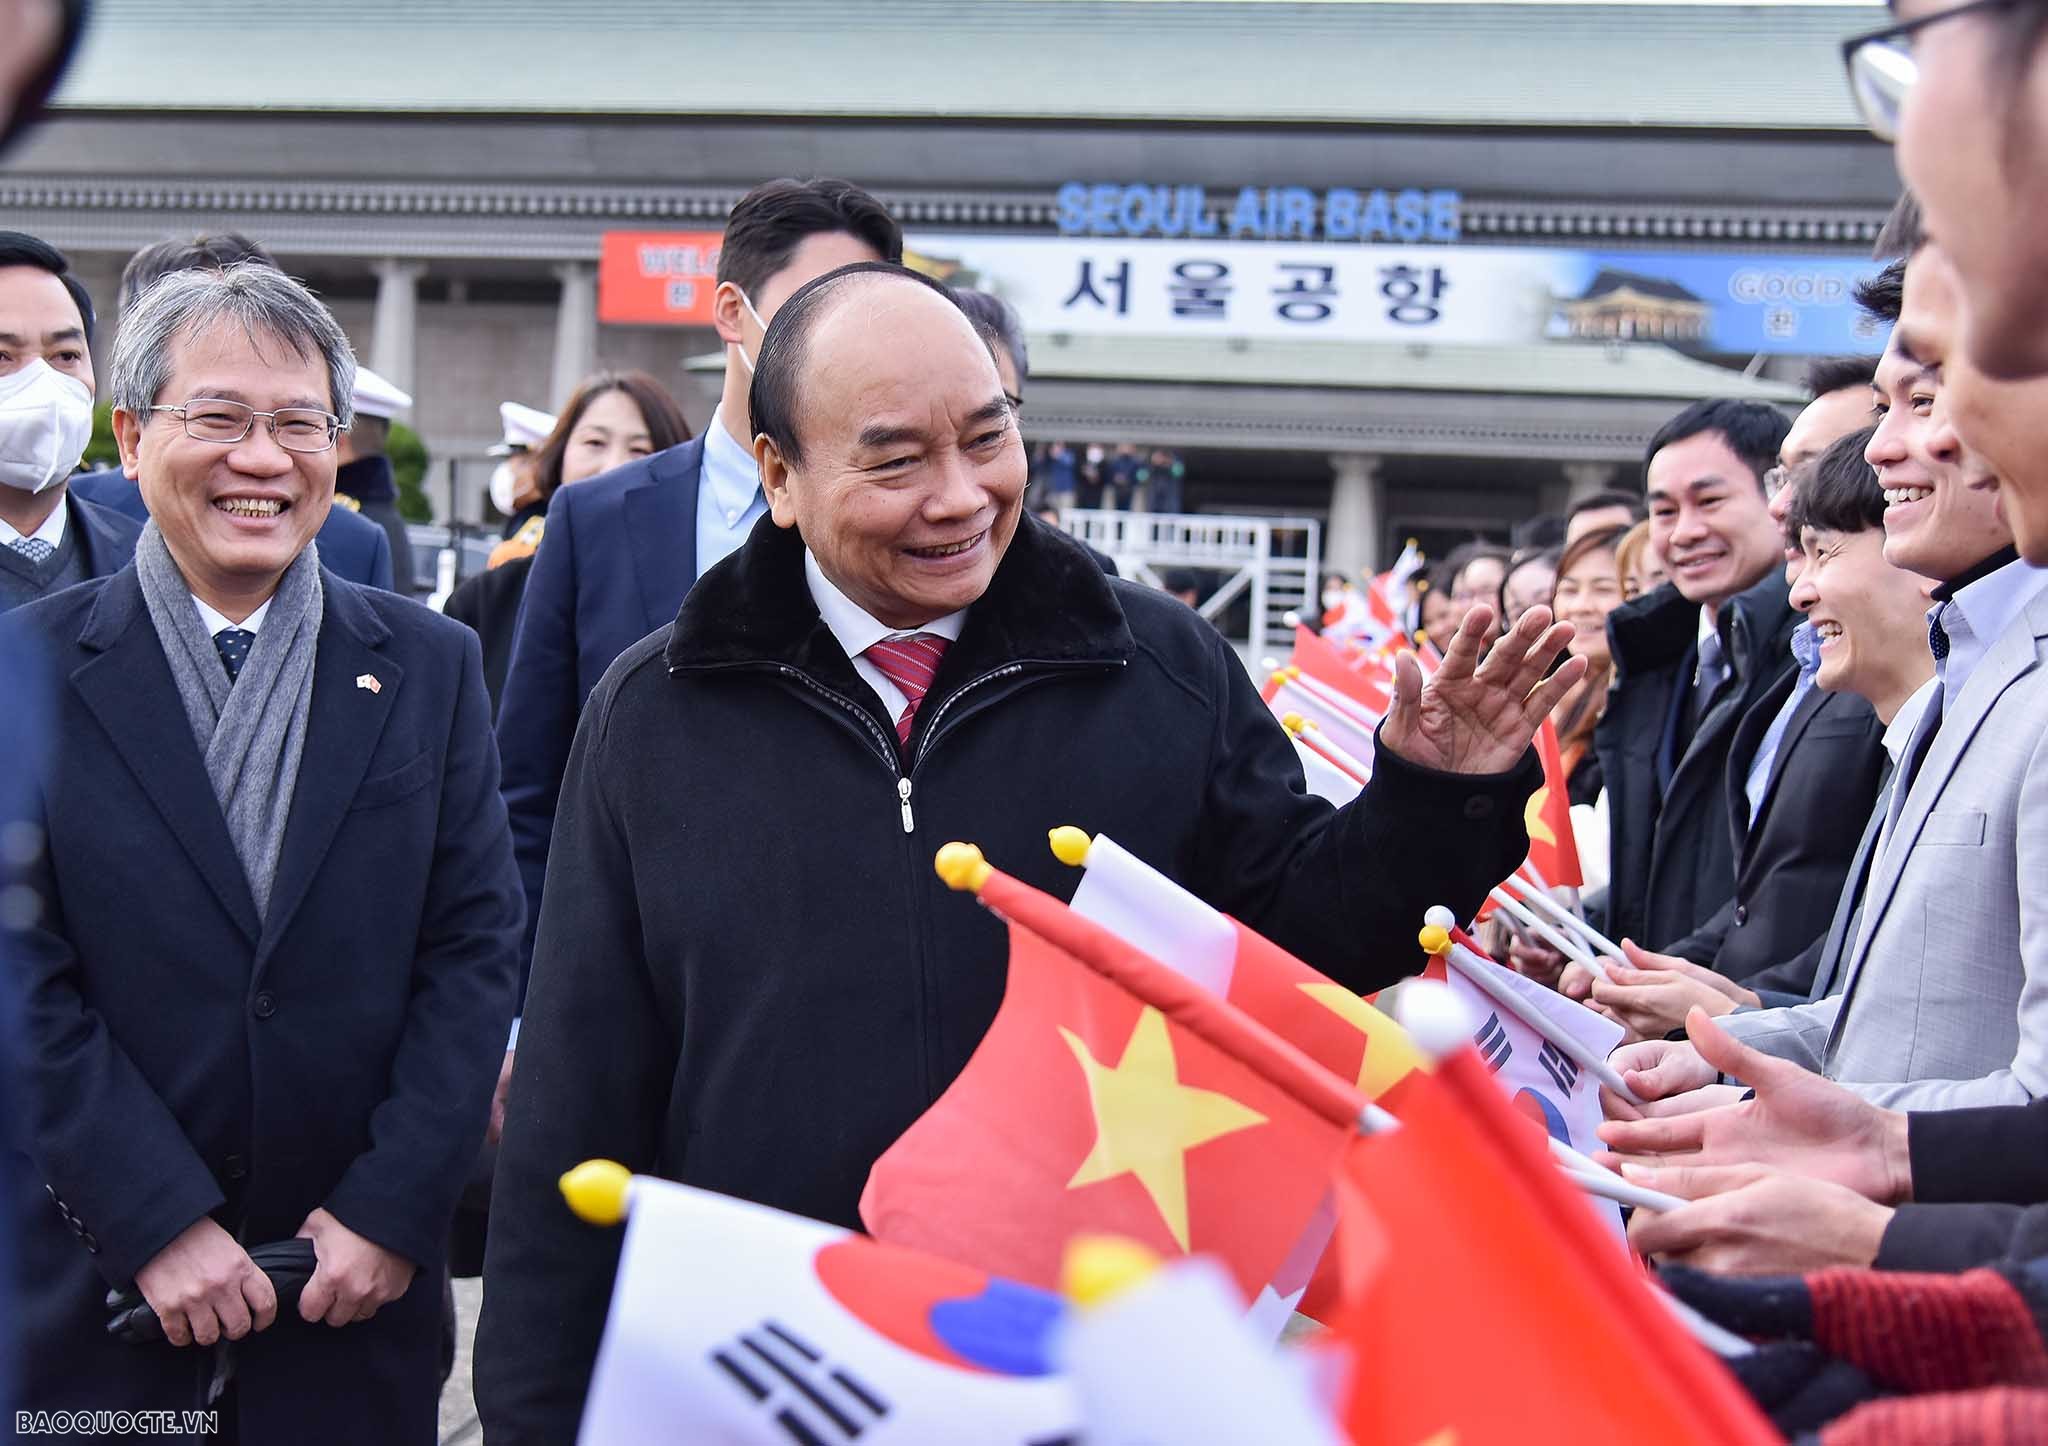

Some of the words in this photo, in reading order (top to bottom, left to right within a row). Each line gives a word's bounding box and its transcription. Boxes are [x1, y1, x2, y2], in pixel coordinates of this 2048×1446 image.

[1056, 183, 1217, 235] SEOUL
[1230, 187, 1317, 238] AIR
[1325, 190, 1462, 241] BASE
[1065, 259, 1451, 325] 서울공항
[1732, 269, 1845, 301] GOOD
